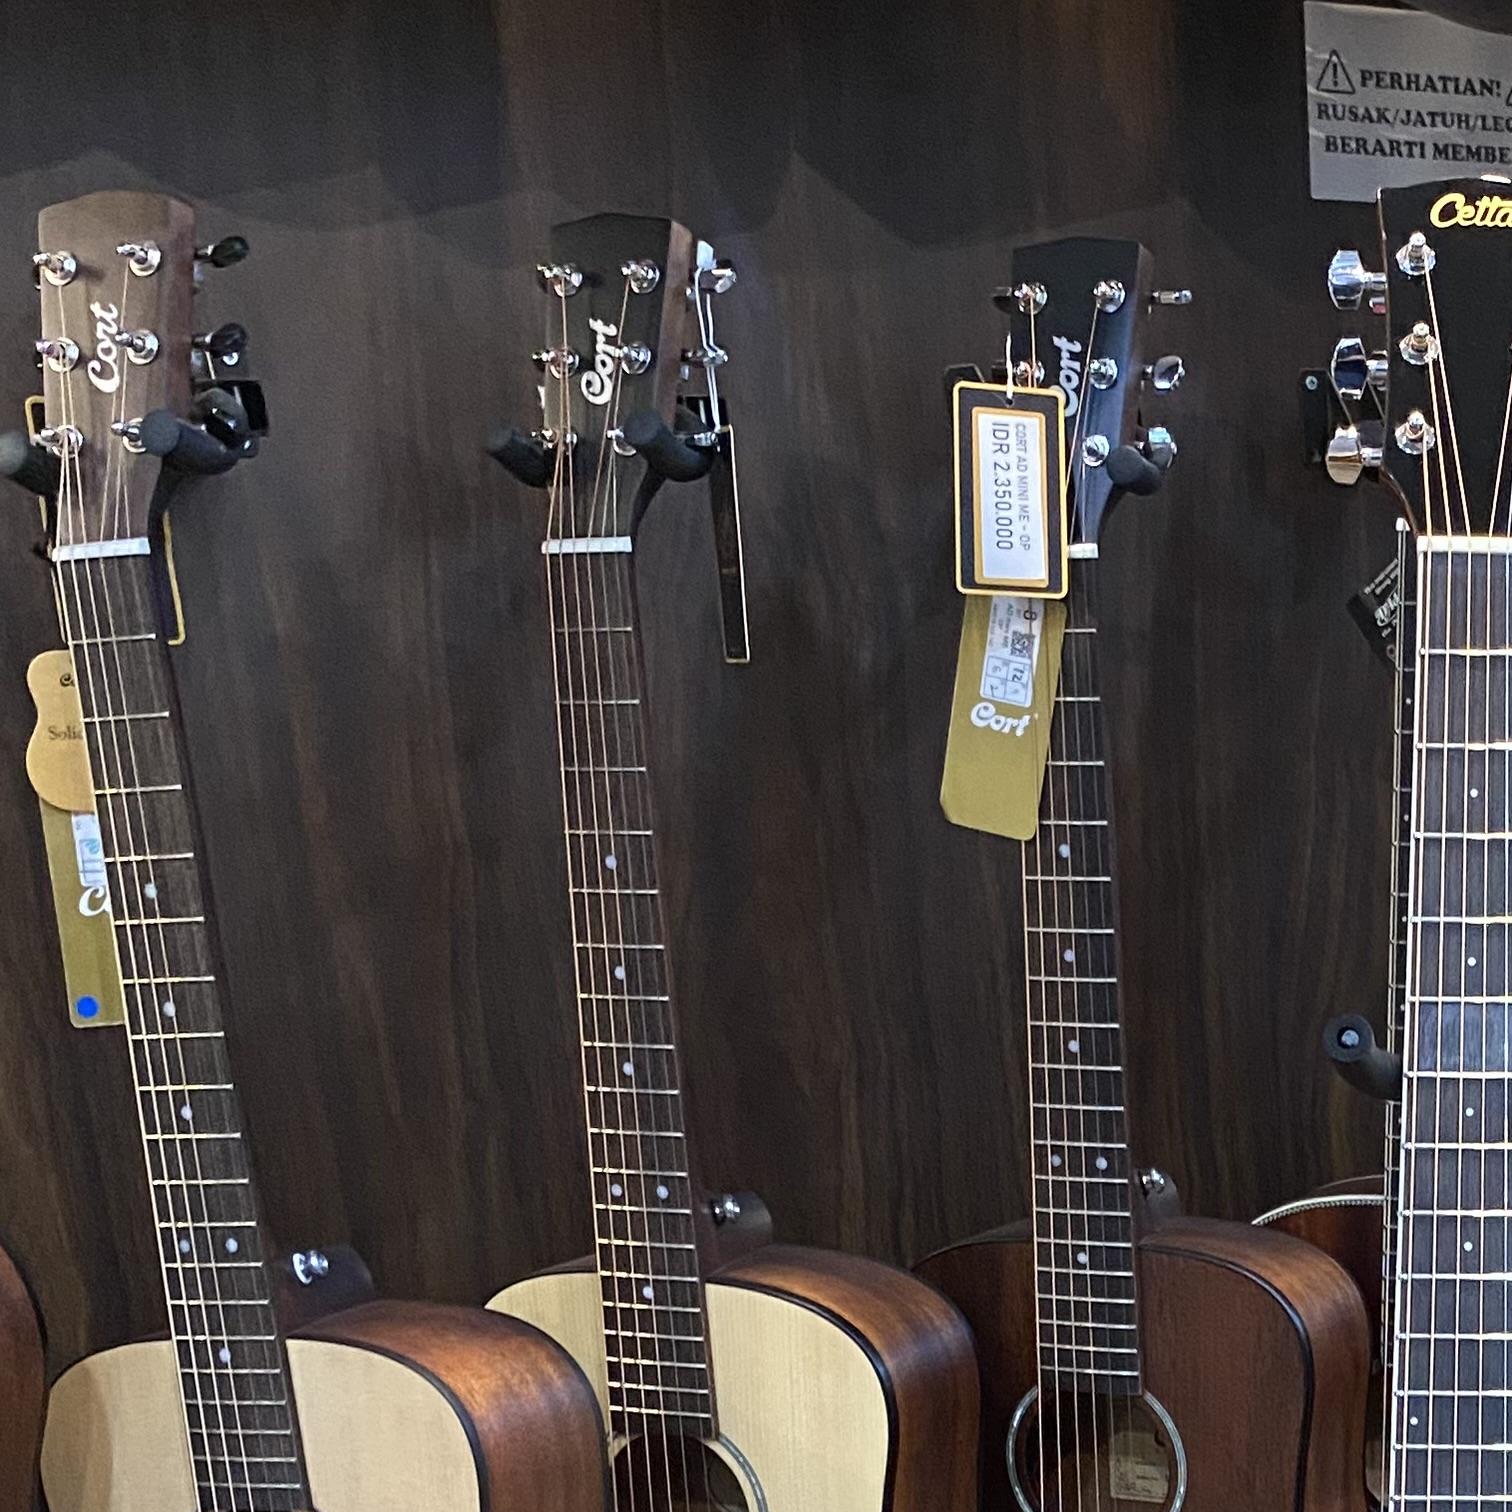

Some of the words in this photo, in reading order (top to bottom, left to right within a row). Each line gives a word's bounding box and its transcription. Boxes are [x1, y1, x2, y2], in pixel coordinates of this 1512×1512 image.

[1359, 69, 1501, 97] PERHATIAN!
[1324, 135, 1426, 159] BERARTI
[87, 301, 120, 393] Cort
[581, 318, 618, 405] Cort
[992, 422, 1010, 455] IDR
[1015, 423, 1027, 453] CORT
[1016, 455, 1028, 472] AD
[1017, 475, 1029, 501] MINI
[993, 461, 1014, 550] 2.350.000
[1019, 503, 1030, 523] ME
[1019, 534, 1030, 551] OP
[970, 702, 1031, 736] Cort
